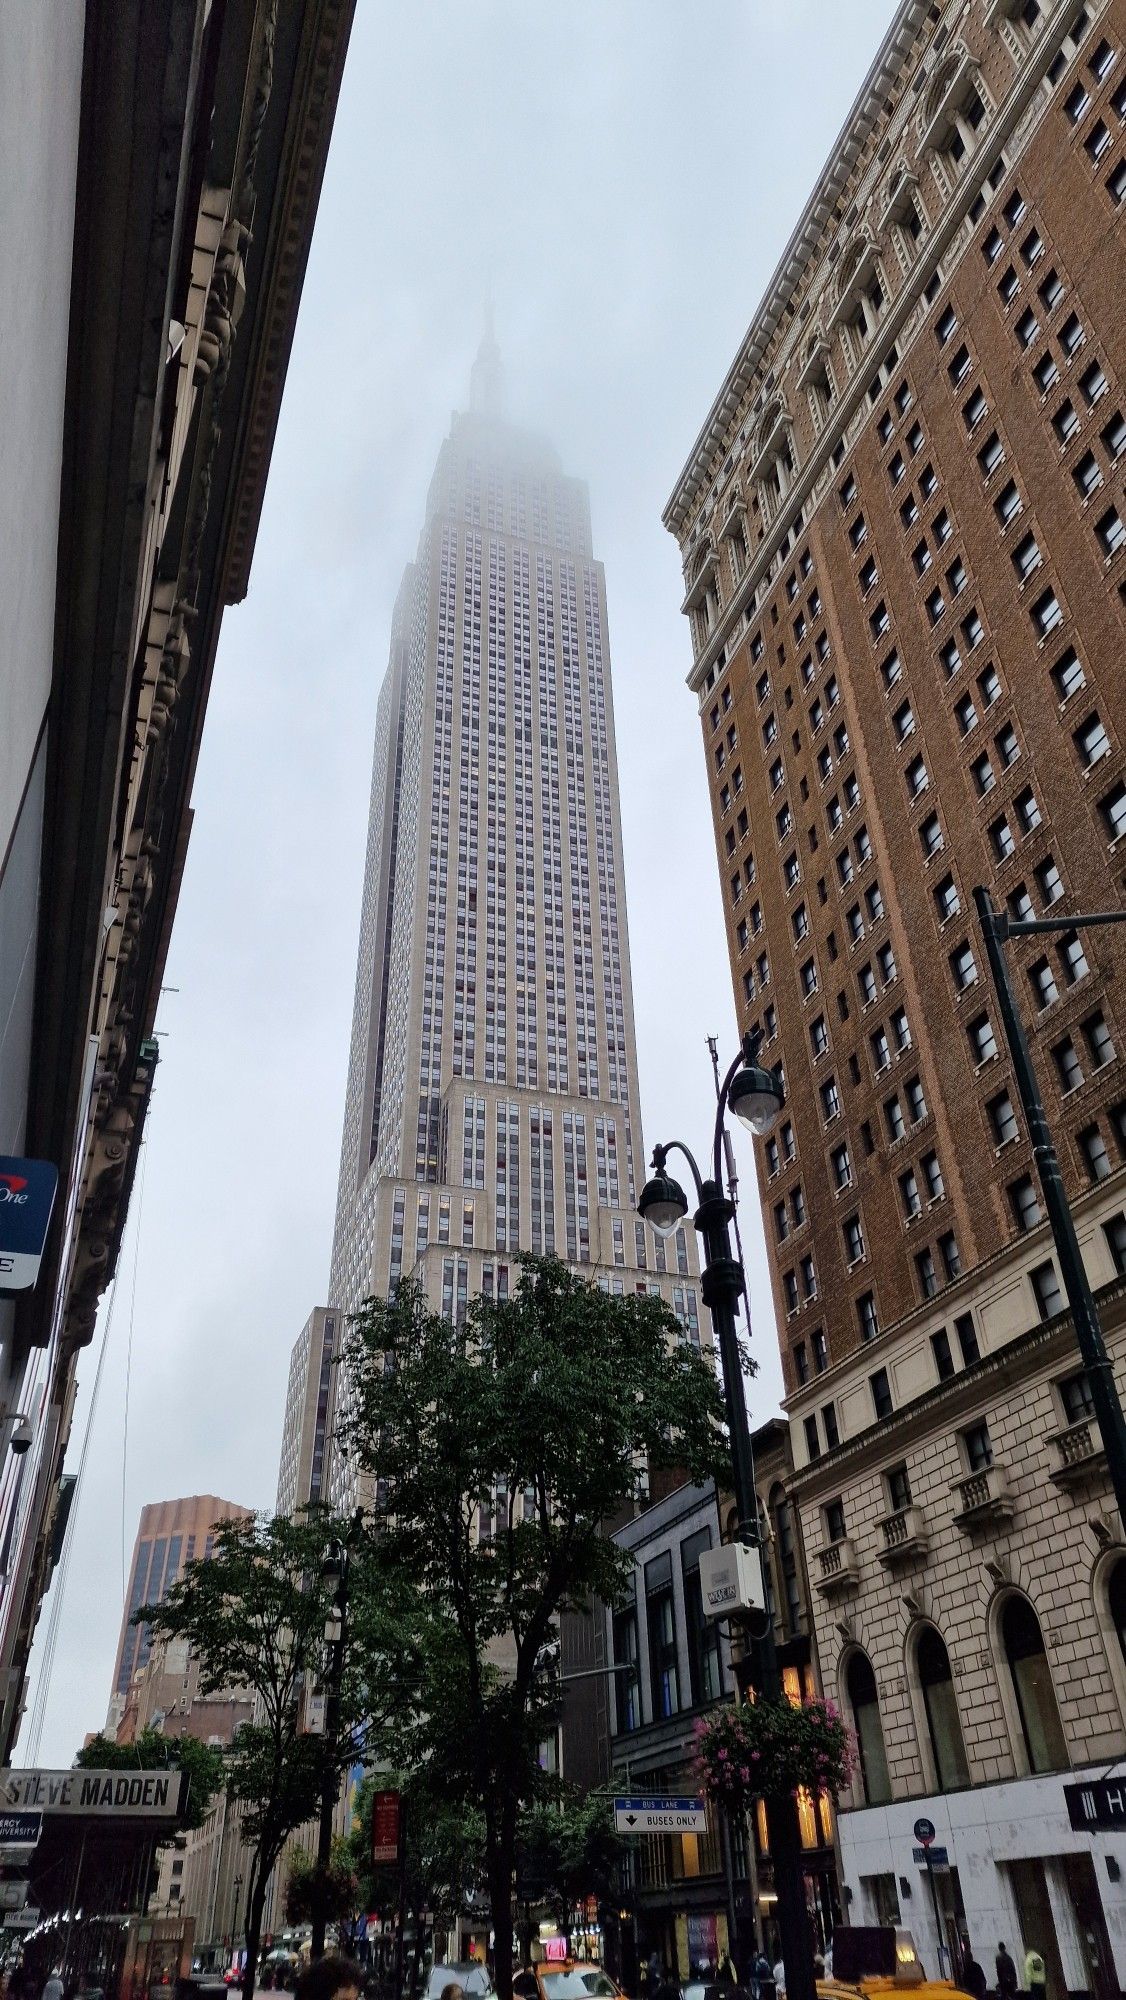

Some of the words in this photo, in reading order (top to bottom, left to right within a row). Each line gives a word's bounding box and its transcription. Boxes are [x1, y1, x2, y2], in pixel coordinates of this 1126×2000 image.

[6, 1778, 74, 1806] STEVE
[80, 1778, 169, 1806] MADDEN
[642, 1801, 655, 1809] BUS
[661, 1801, 679, 1809] LANE
[647, 1816, 673, 1826] BUSES
[676, 1816, 697, 1826] ONLY
